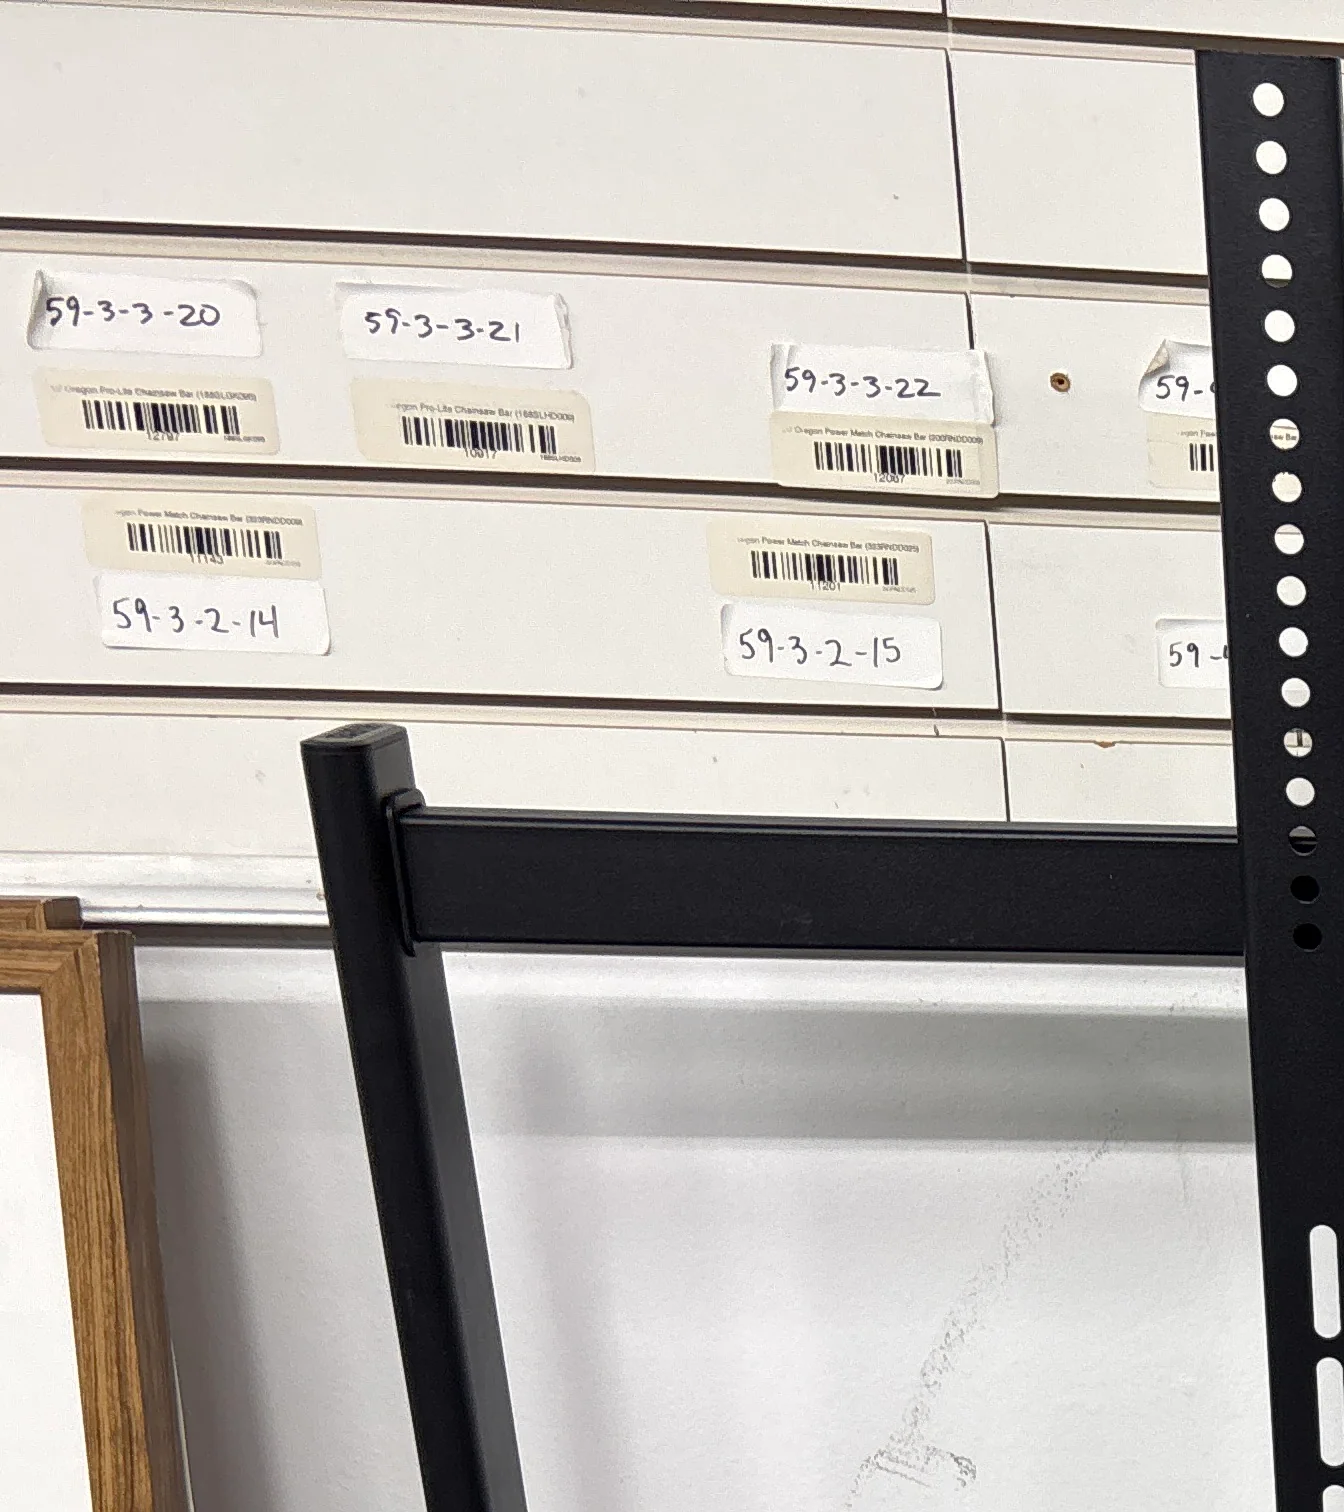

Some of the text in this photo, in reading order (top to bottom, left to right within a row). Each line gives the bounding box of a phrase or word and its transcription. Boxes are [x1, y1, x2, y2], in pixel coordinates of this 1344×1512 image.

[46, 296, 221, 327] 59-3-3-20
[364, 308, 521, 342] 59-3-3-21
[784, 367, 942, 398] 59-3-3-22
[112, 597, 280, 638] 59-3-2-14
[739, 627, 902, 668] 59-3-2-15
